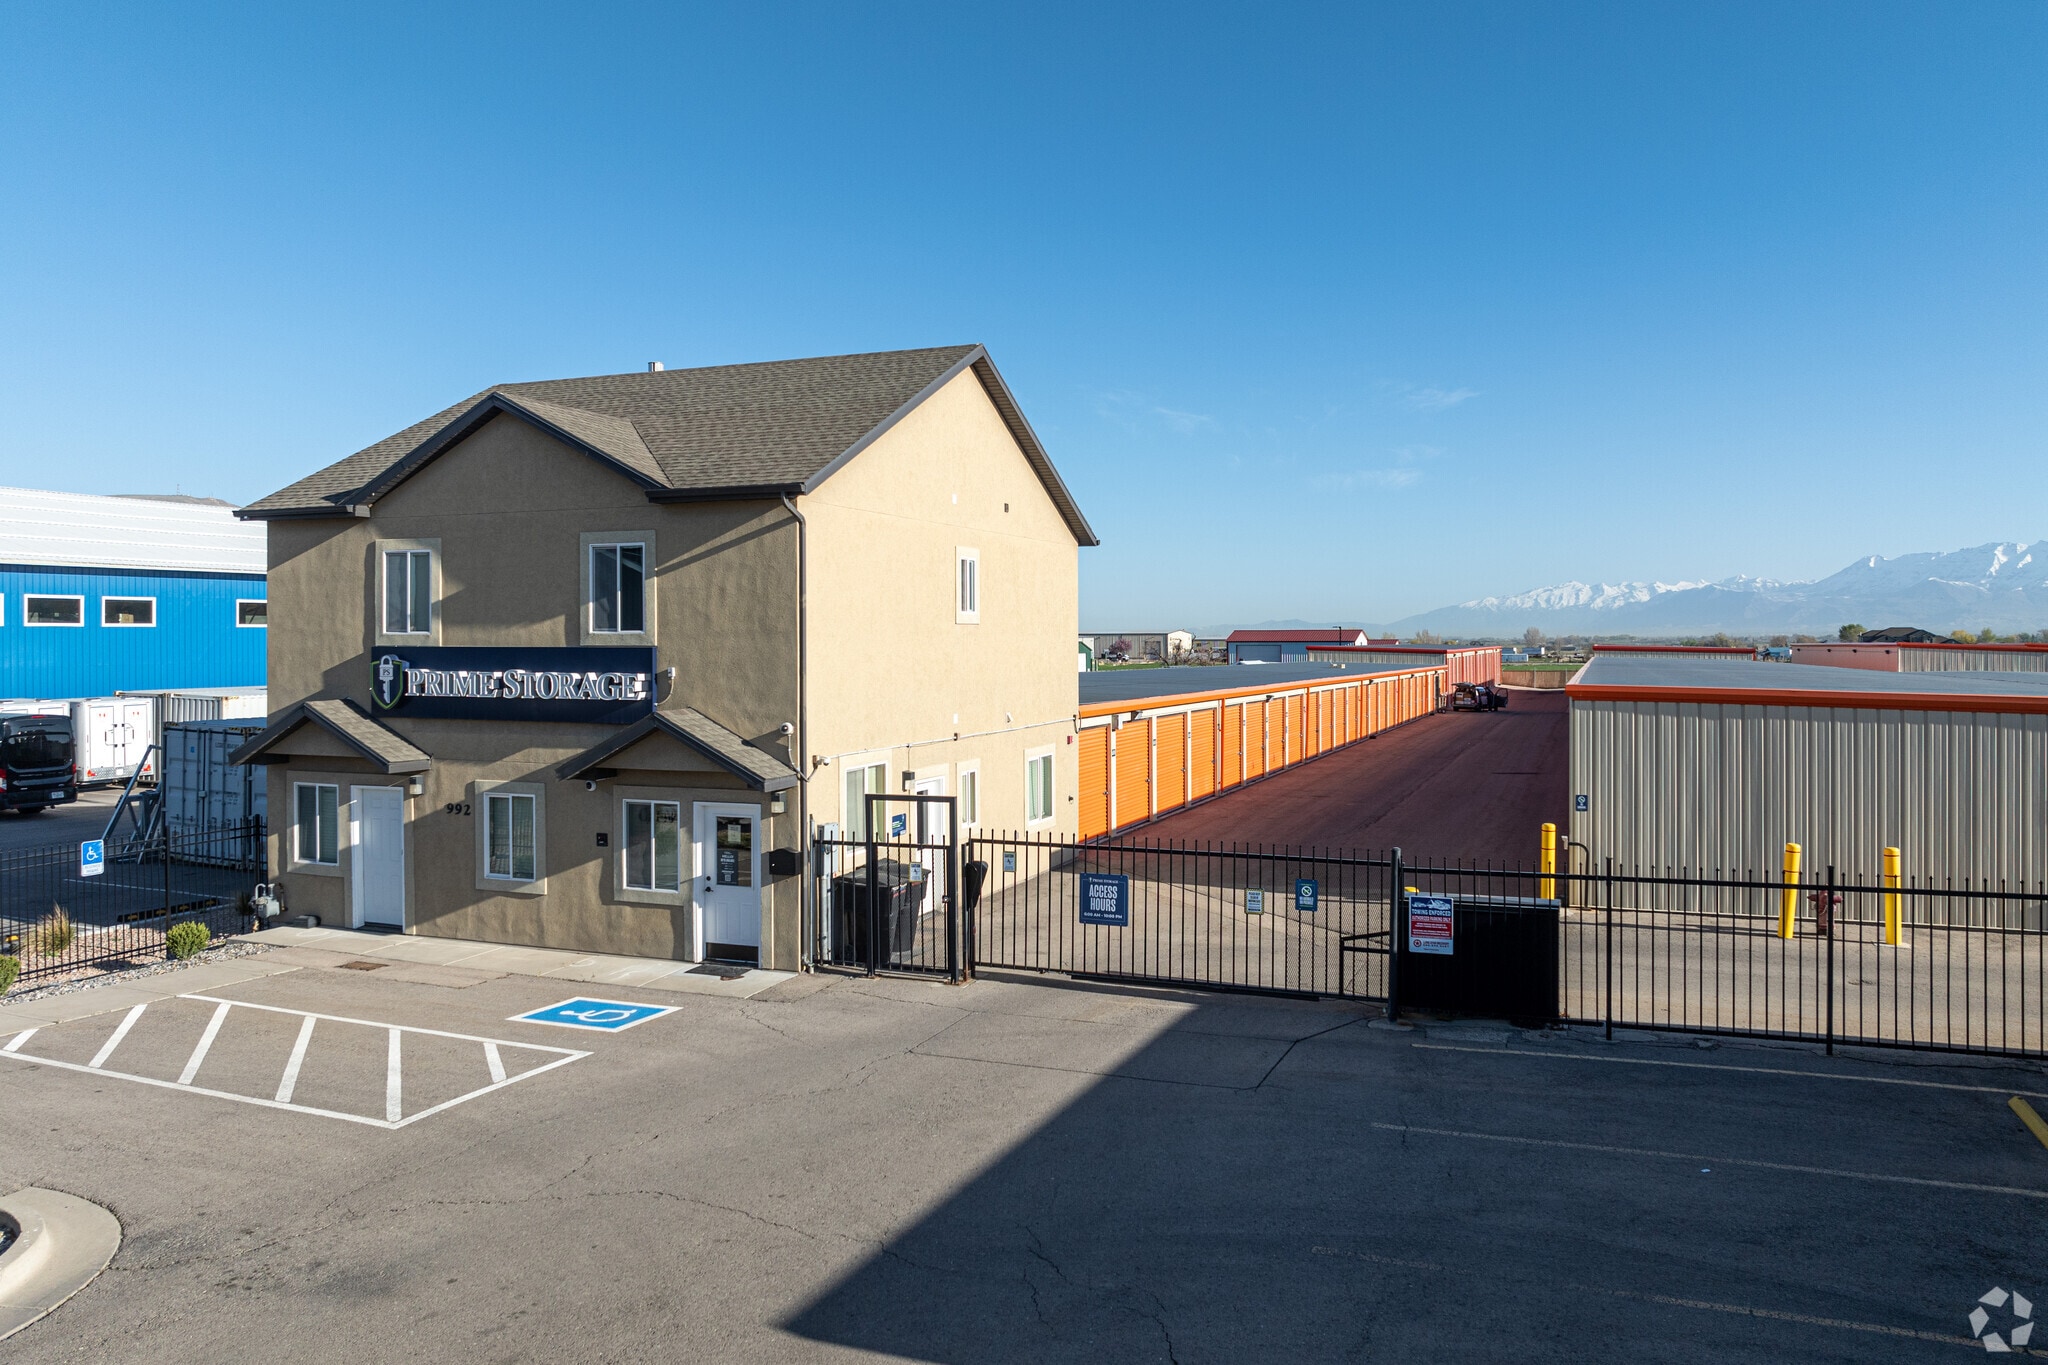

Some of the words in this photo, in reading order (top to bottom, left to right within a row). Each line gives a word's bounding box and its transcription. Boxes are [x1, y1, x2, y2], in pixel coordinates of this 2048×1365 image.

[404, 668, 497, 697] PRIME
[503, 669, 640, 701] STORAGE
[446, 803, 472, 816] 992
[1089, 884, 1118, 899] ACCESS
[1090, 897, 1116, 912] HOURS
